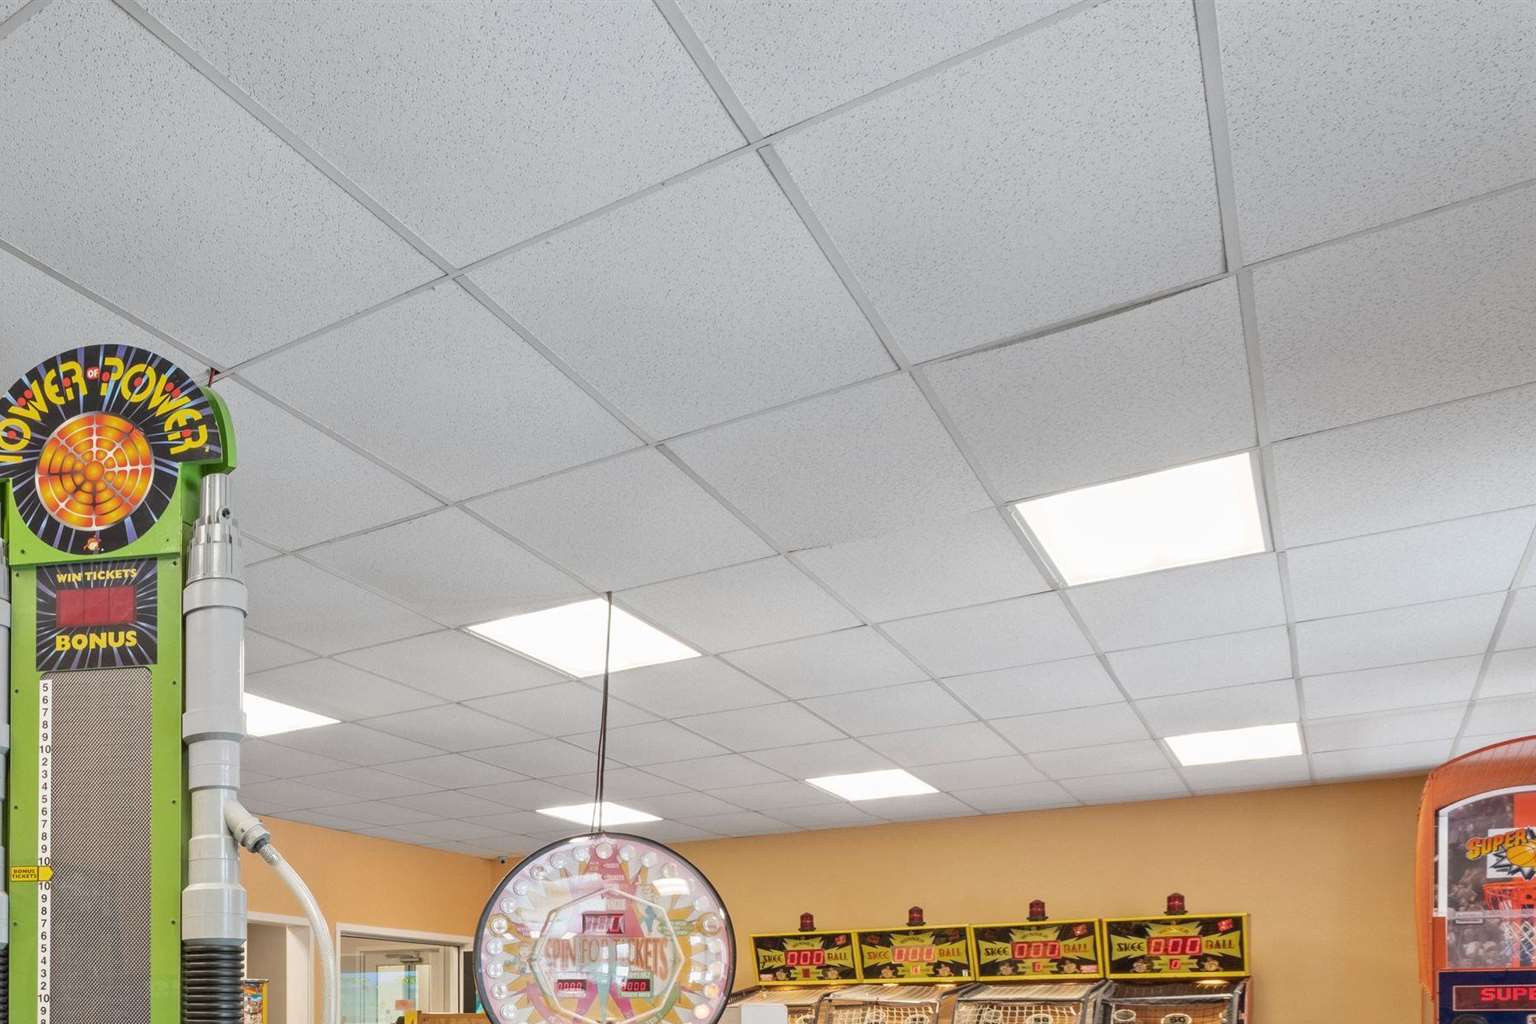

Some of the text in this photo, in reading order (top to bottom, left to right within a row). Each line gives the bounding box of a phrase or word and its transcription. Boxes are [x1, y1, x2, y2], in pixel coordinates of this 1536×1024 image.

[87, 367, 100, 380] OF
[99, 356, 208, 455] POWER
[56, 568, 137, 583] WIN TICKETS
[55, 630, 137, 652] BONUS
[42, 682, 48, 693] 5
[42, 695, 48, 704] 6
[42, 707, 48, 717] 7
[42, 719, 48, 729] 8
[42, 732, 48, 742] 9
[40, 745, 51, 755] 10
[42, 757, 48, 767] 2
[42, 769, 48, 779] 3
[42, 781, 48, 791] 4
[41, 794, 48, 804] 5
[41, 807, 48, 816] 6
[41, 819, 48, 829] 7
[41, 831, 48, 841] 8
[41, 844, 48, 854] 9
[1465, 829, 1528, 861] SUPER
[39, 856, 50, 867] 10
[39, 882, 50, 891] 10
[41, 893, 47, 903] 9
[41, 906, 47, 916] 8
[41, 918, 47, 929] 7
[41, 931, 47, 941] 6
[41, 943, 47, 954] 5
[1150, 937, 1201, 955] 000
[40, 956, 47, 966] 4
[40, 968, 47, 979] 3
[40, 981, 47, 991] 2
[38, 993, 49, 1004] 10
[40, 1006, 47, 1017] 9
